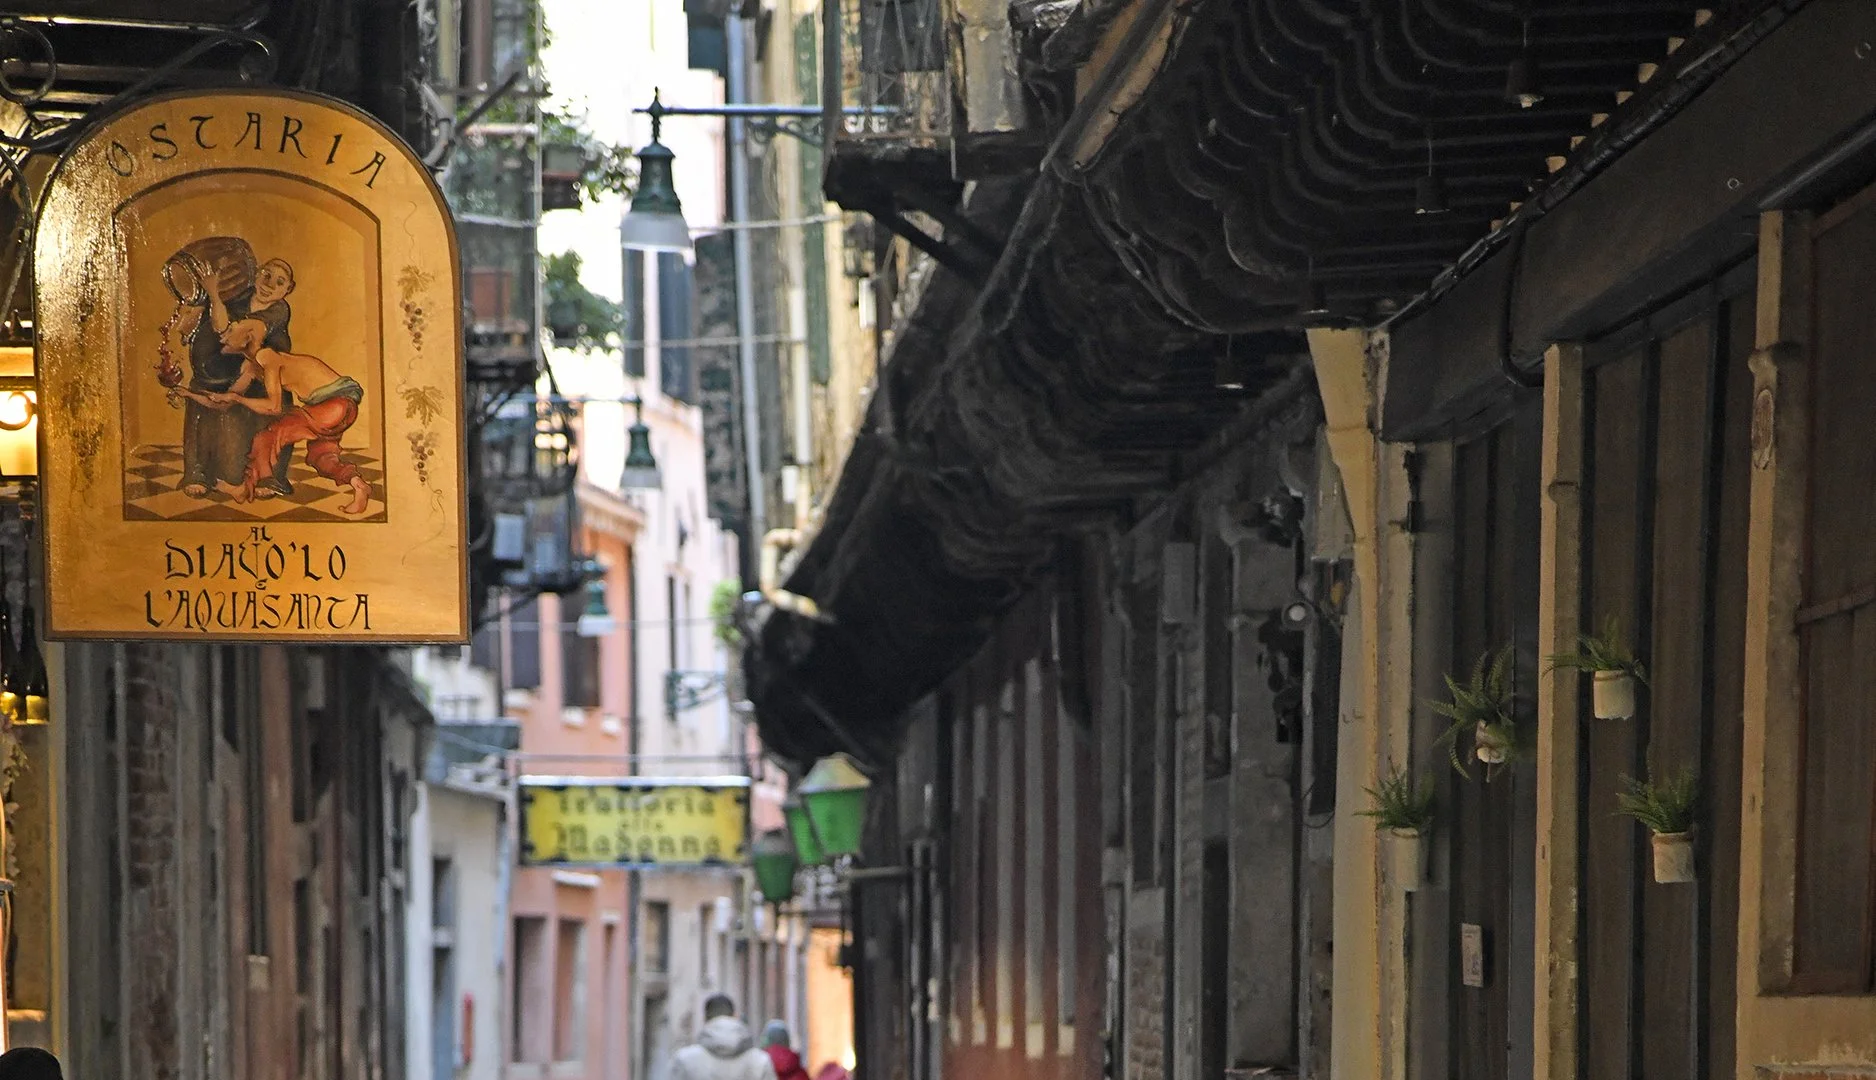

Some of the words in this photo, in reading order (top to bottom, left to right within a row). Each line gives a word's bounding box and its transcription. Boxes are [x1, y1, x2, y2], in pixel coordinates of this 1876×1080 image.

[105, 112, 386, 189] OSTARIA
[248, 525, 273, 541] AL
[144, 588, 372, 632] L'AQUASANTA
